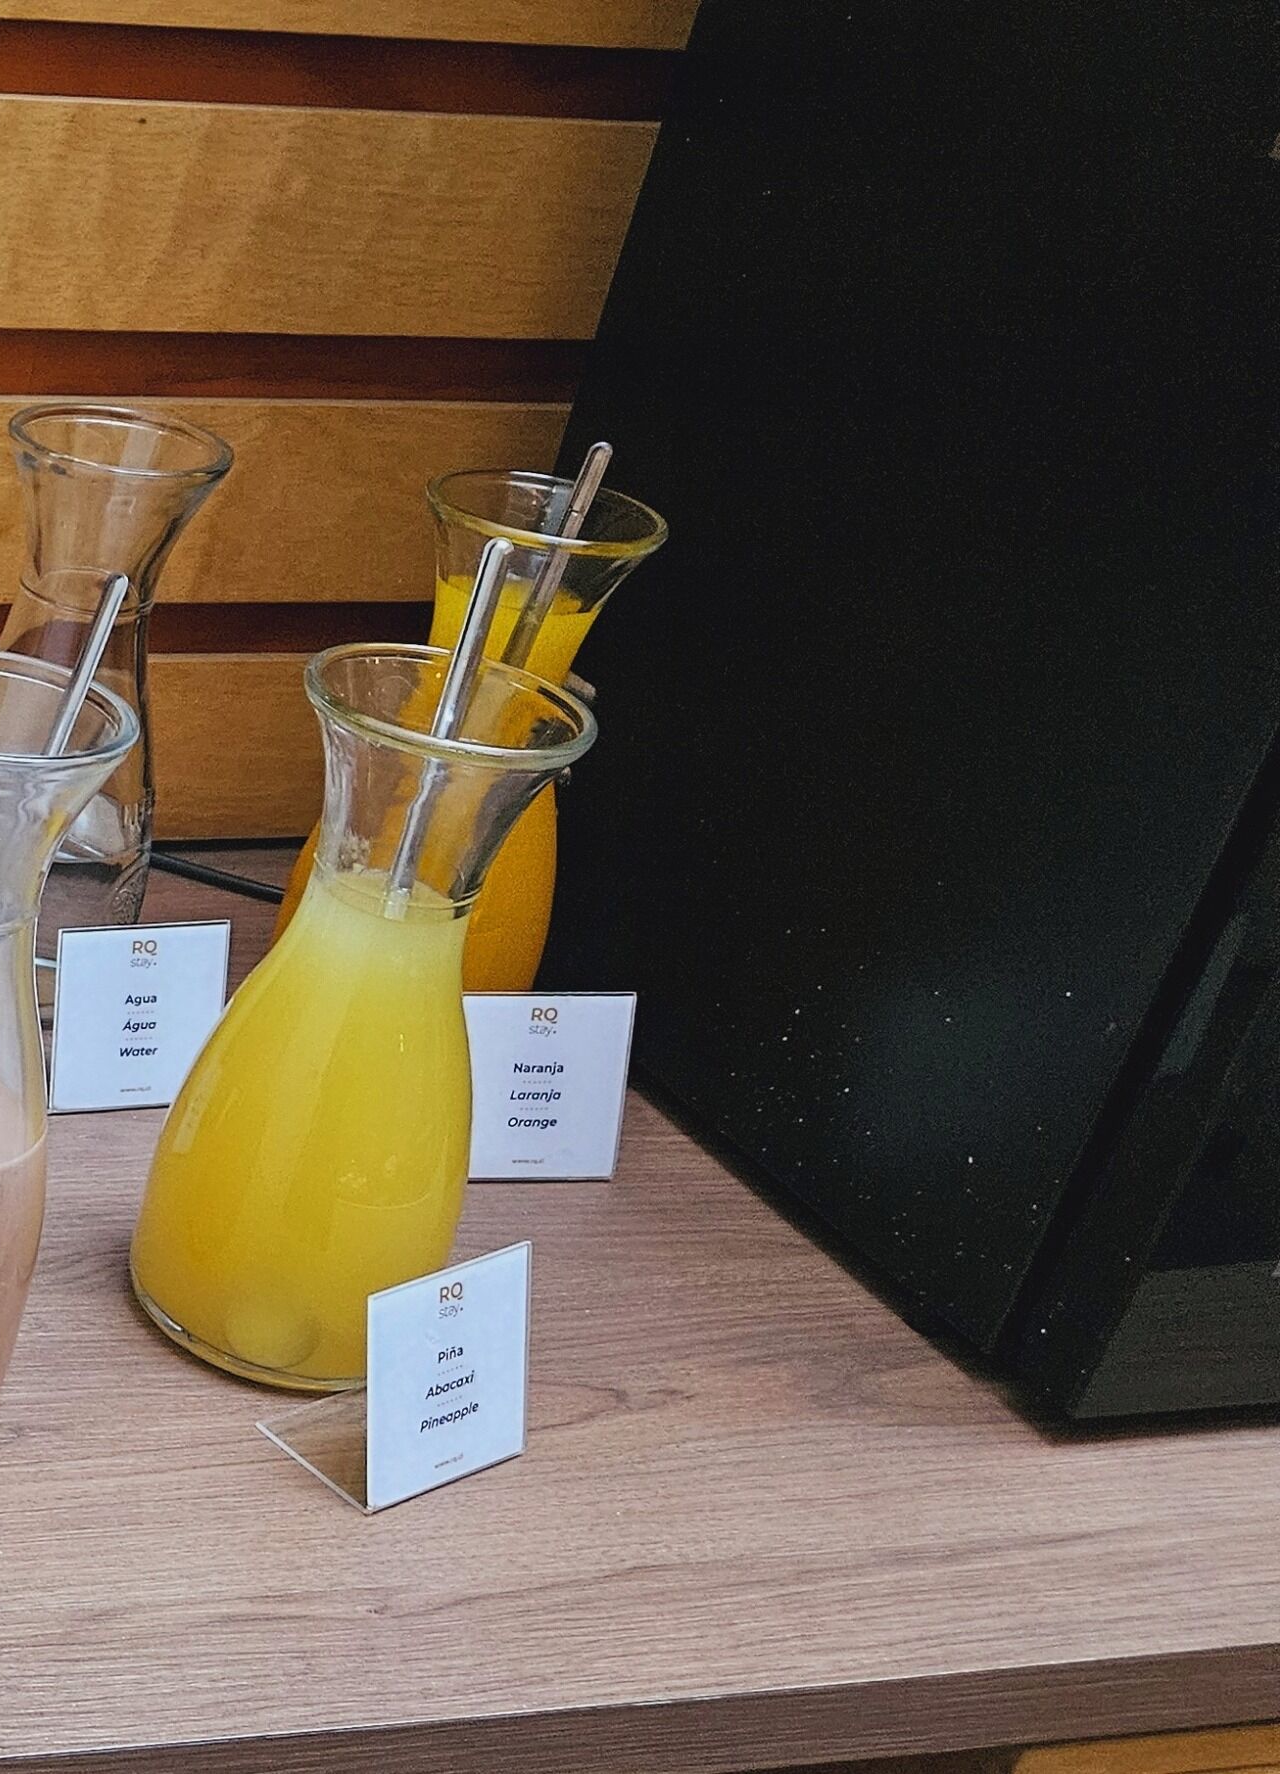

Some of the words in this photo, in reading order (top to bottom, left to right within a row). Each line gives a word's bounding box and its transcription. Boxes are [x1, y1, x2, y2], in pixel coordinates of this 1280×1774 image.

[124, 993, 157, 1007] Agua
[531, 1007, 558, 1024] RQ
[122, 1017, 157, 1033] Água
[119, 1046, 158, 1058] Water
[513, 1061, 564, 1076] Naranja
[510, 1088, 561, 1103] Laranja
[507, 1117, 558, 1130] Orange
[439, 1281, 464, 1304] RQ
[437, 1346, 464, 1364] Piña
[425, 1370, 475, 1400] Abacaxi
[420, 1400, 479, 1433] Pineapple
